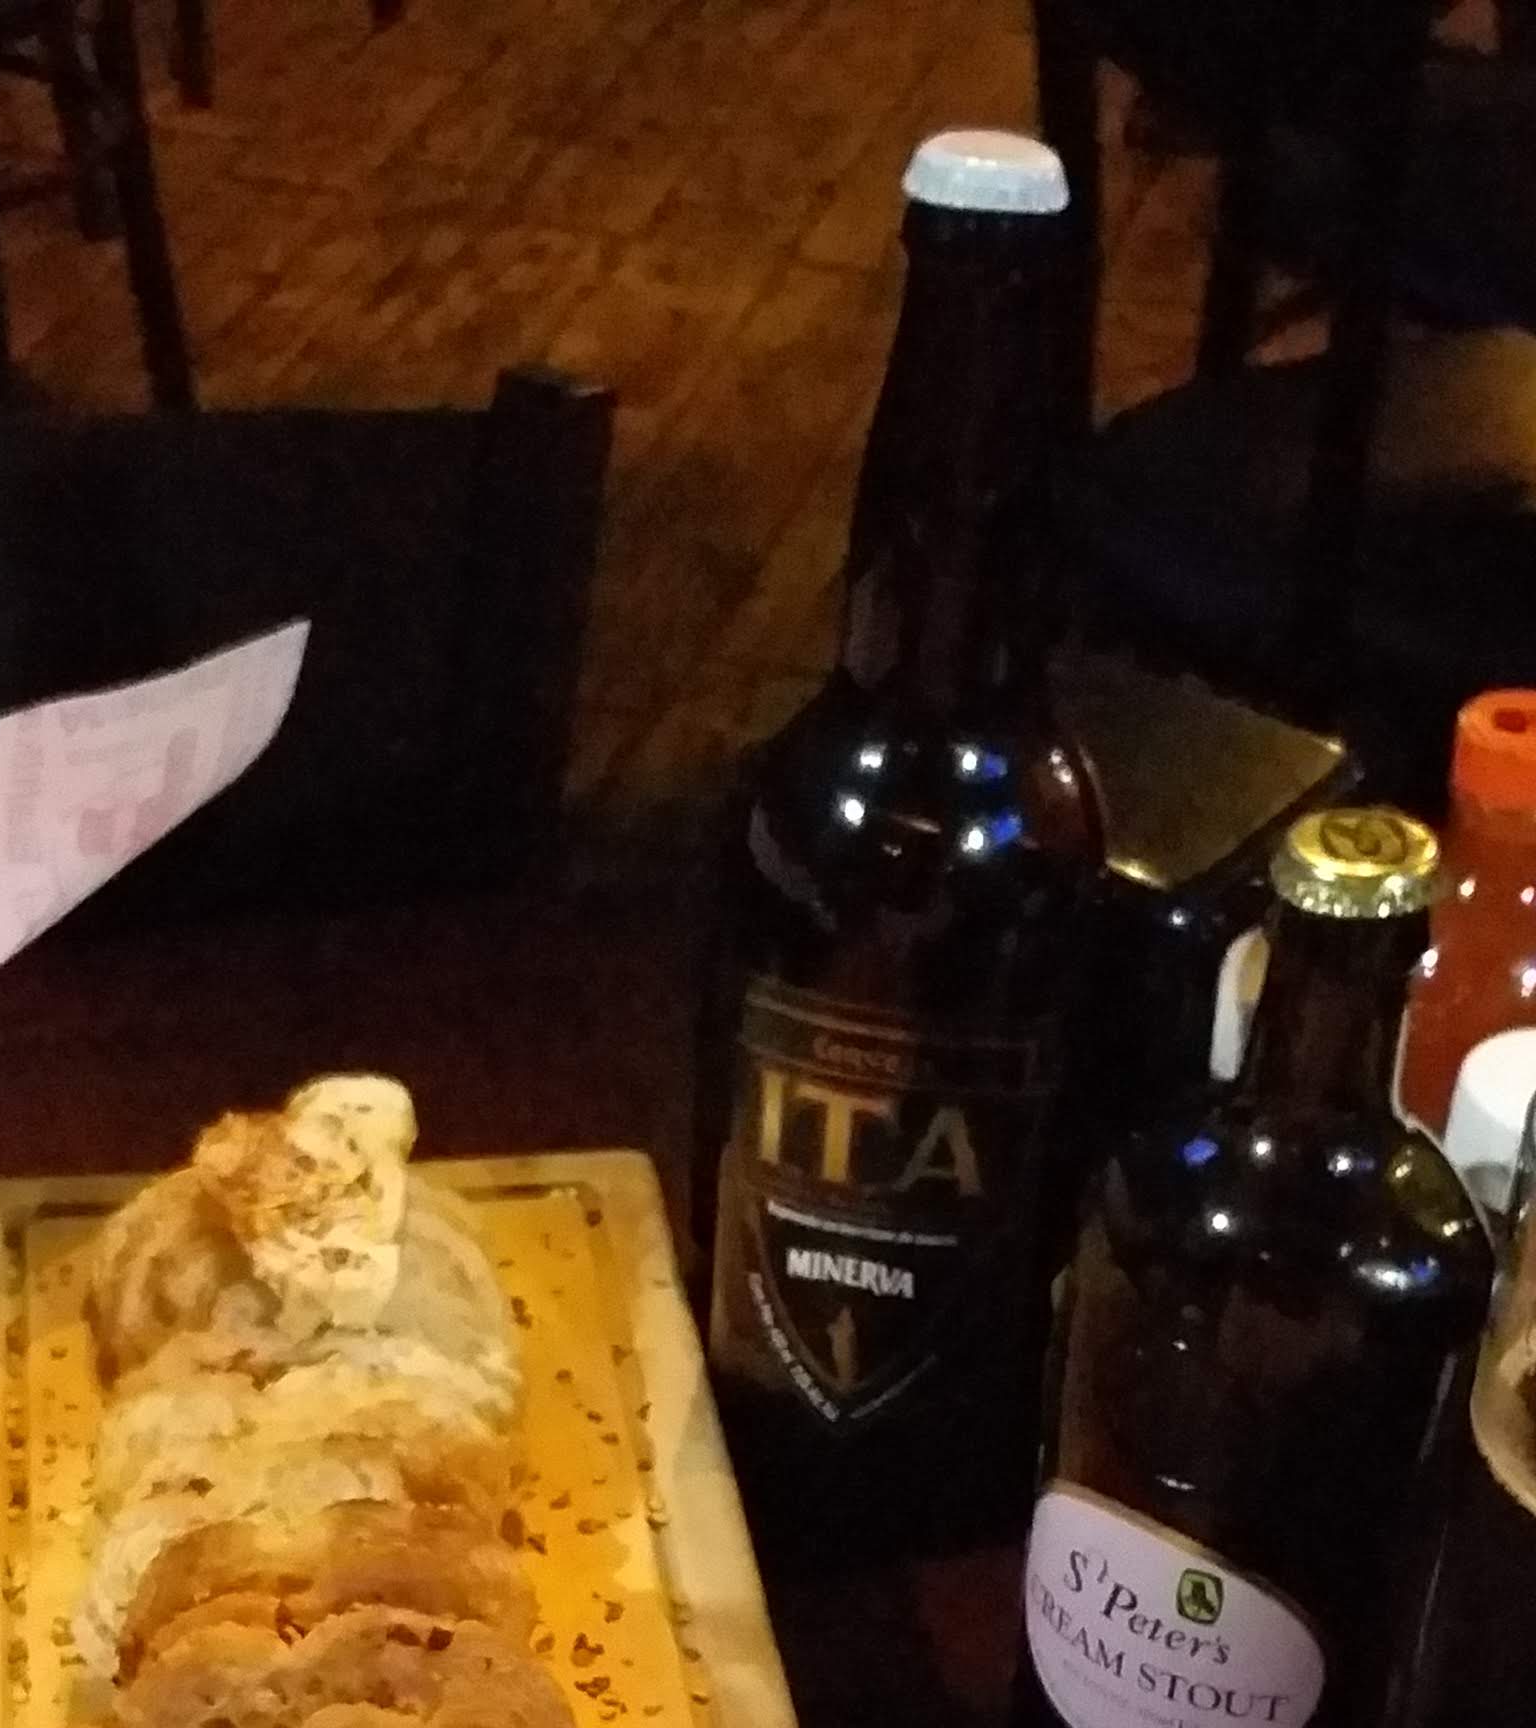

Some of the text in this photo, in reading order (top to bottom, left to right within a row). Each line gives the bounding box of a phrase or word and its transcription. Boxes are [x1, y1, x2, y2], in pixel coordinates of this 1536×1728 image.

[785, 1246, 915, 1299] MINERVA
[1101, 1583, 1232, 1666] Peter's
[1137, 1662, 1291, 1722] STOUT
